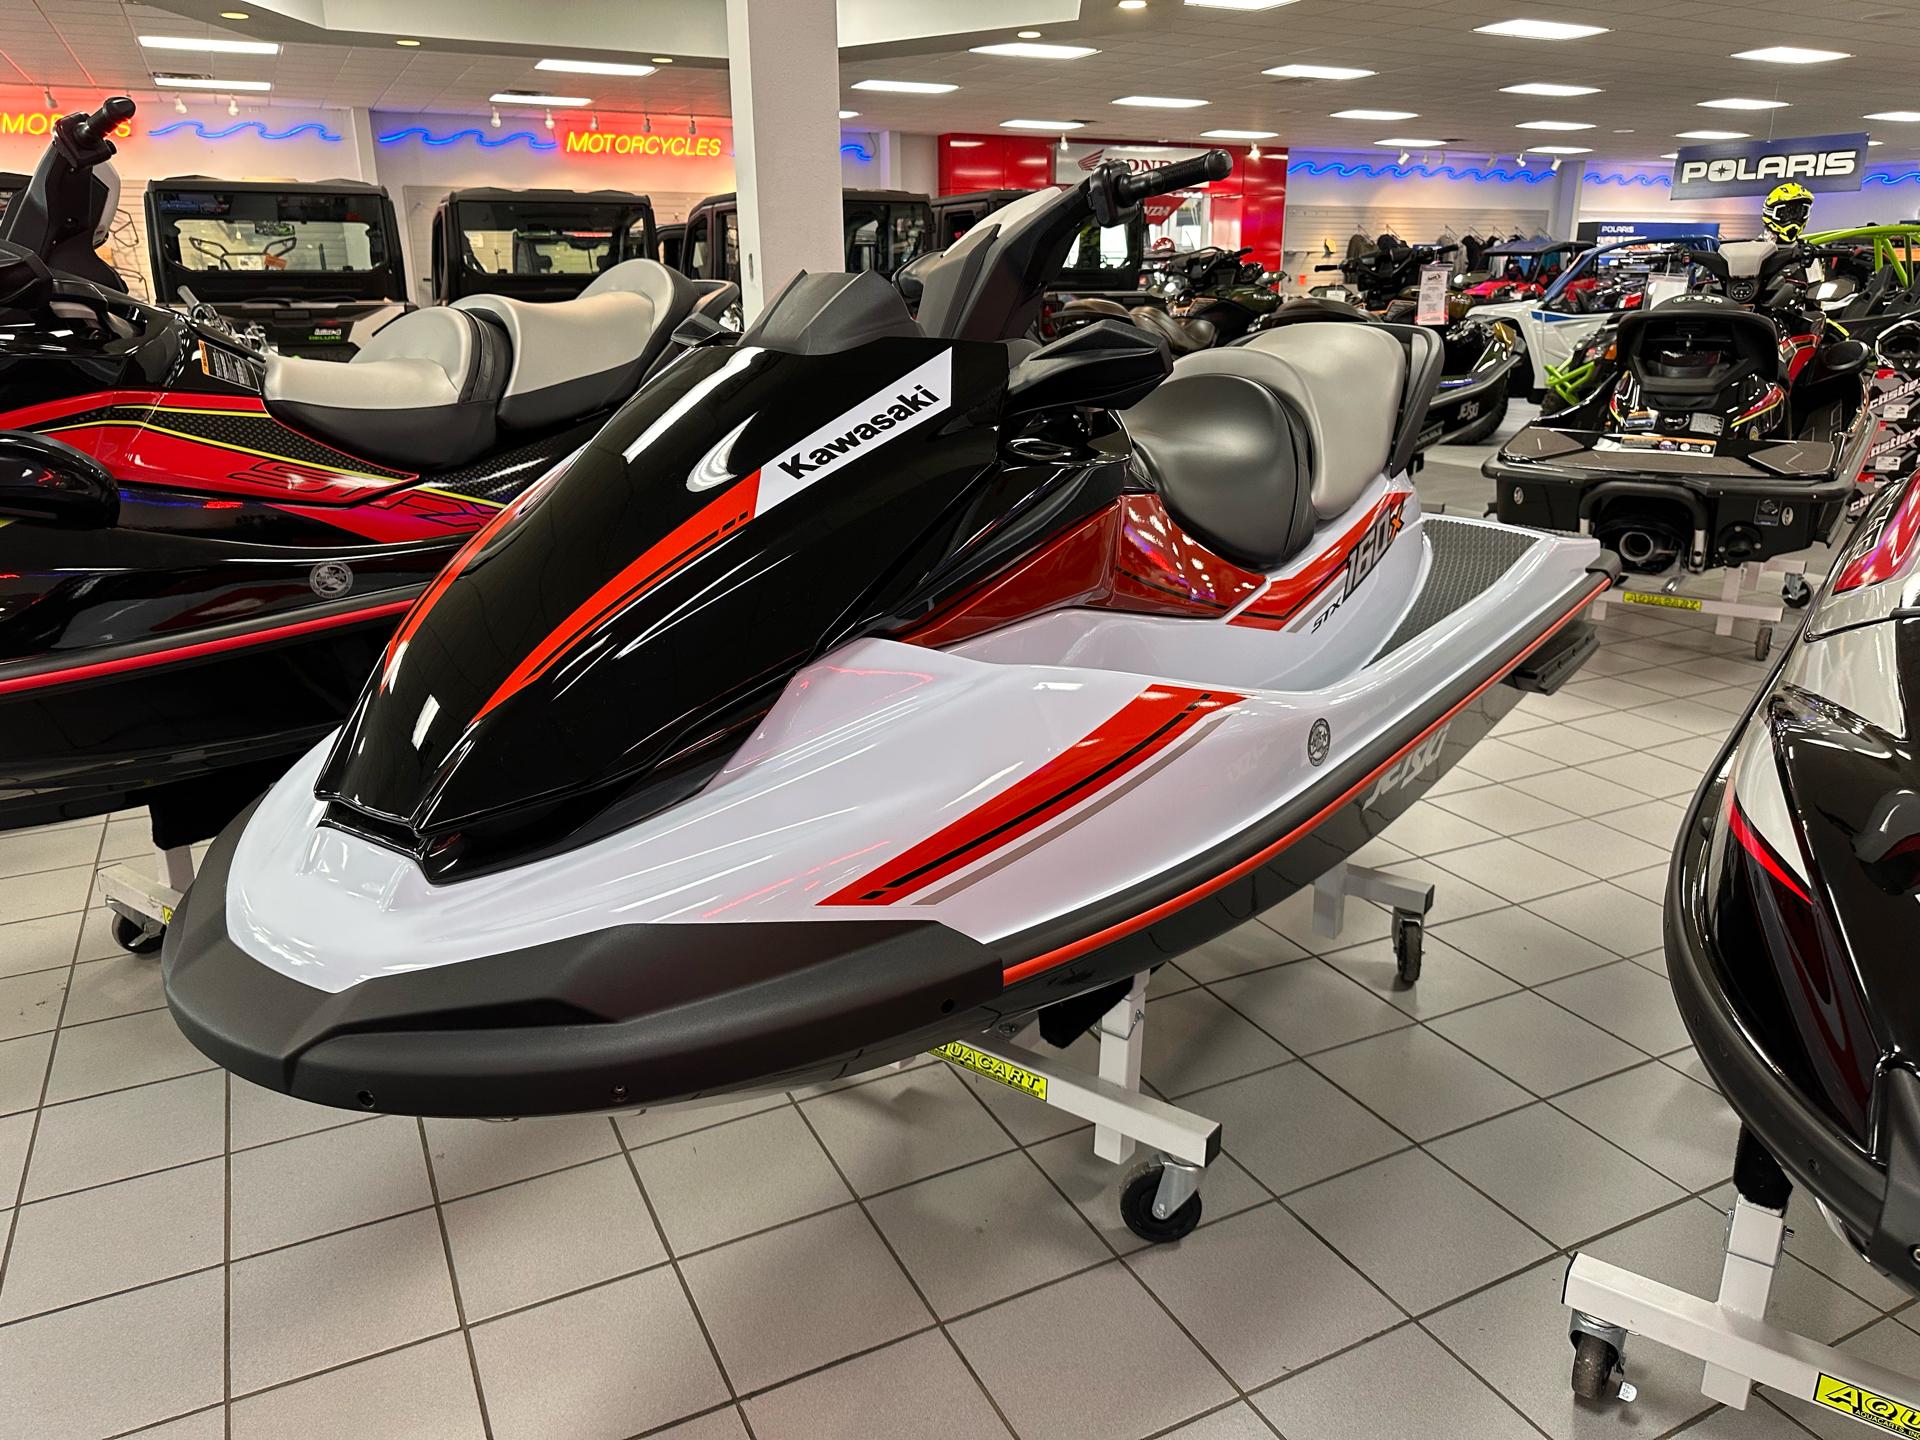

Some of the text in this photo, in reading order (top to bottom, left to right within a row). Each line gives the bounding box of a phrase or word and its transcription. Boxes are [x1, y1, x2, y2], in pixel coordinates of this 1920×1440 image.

[566, 131, 721, 156] MOTORCYCLES
[1681, 150, 1857, 184] POLARIS
[777, 384, 940, 480] Kawasaki
[1310, 596, 1343, 634] STX
